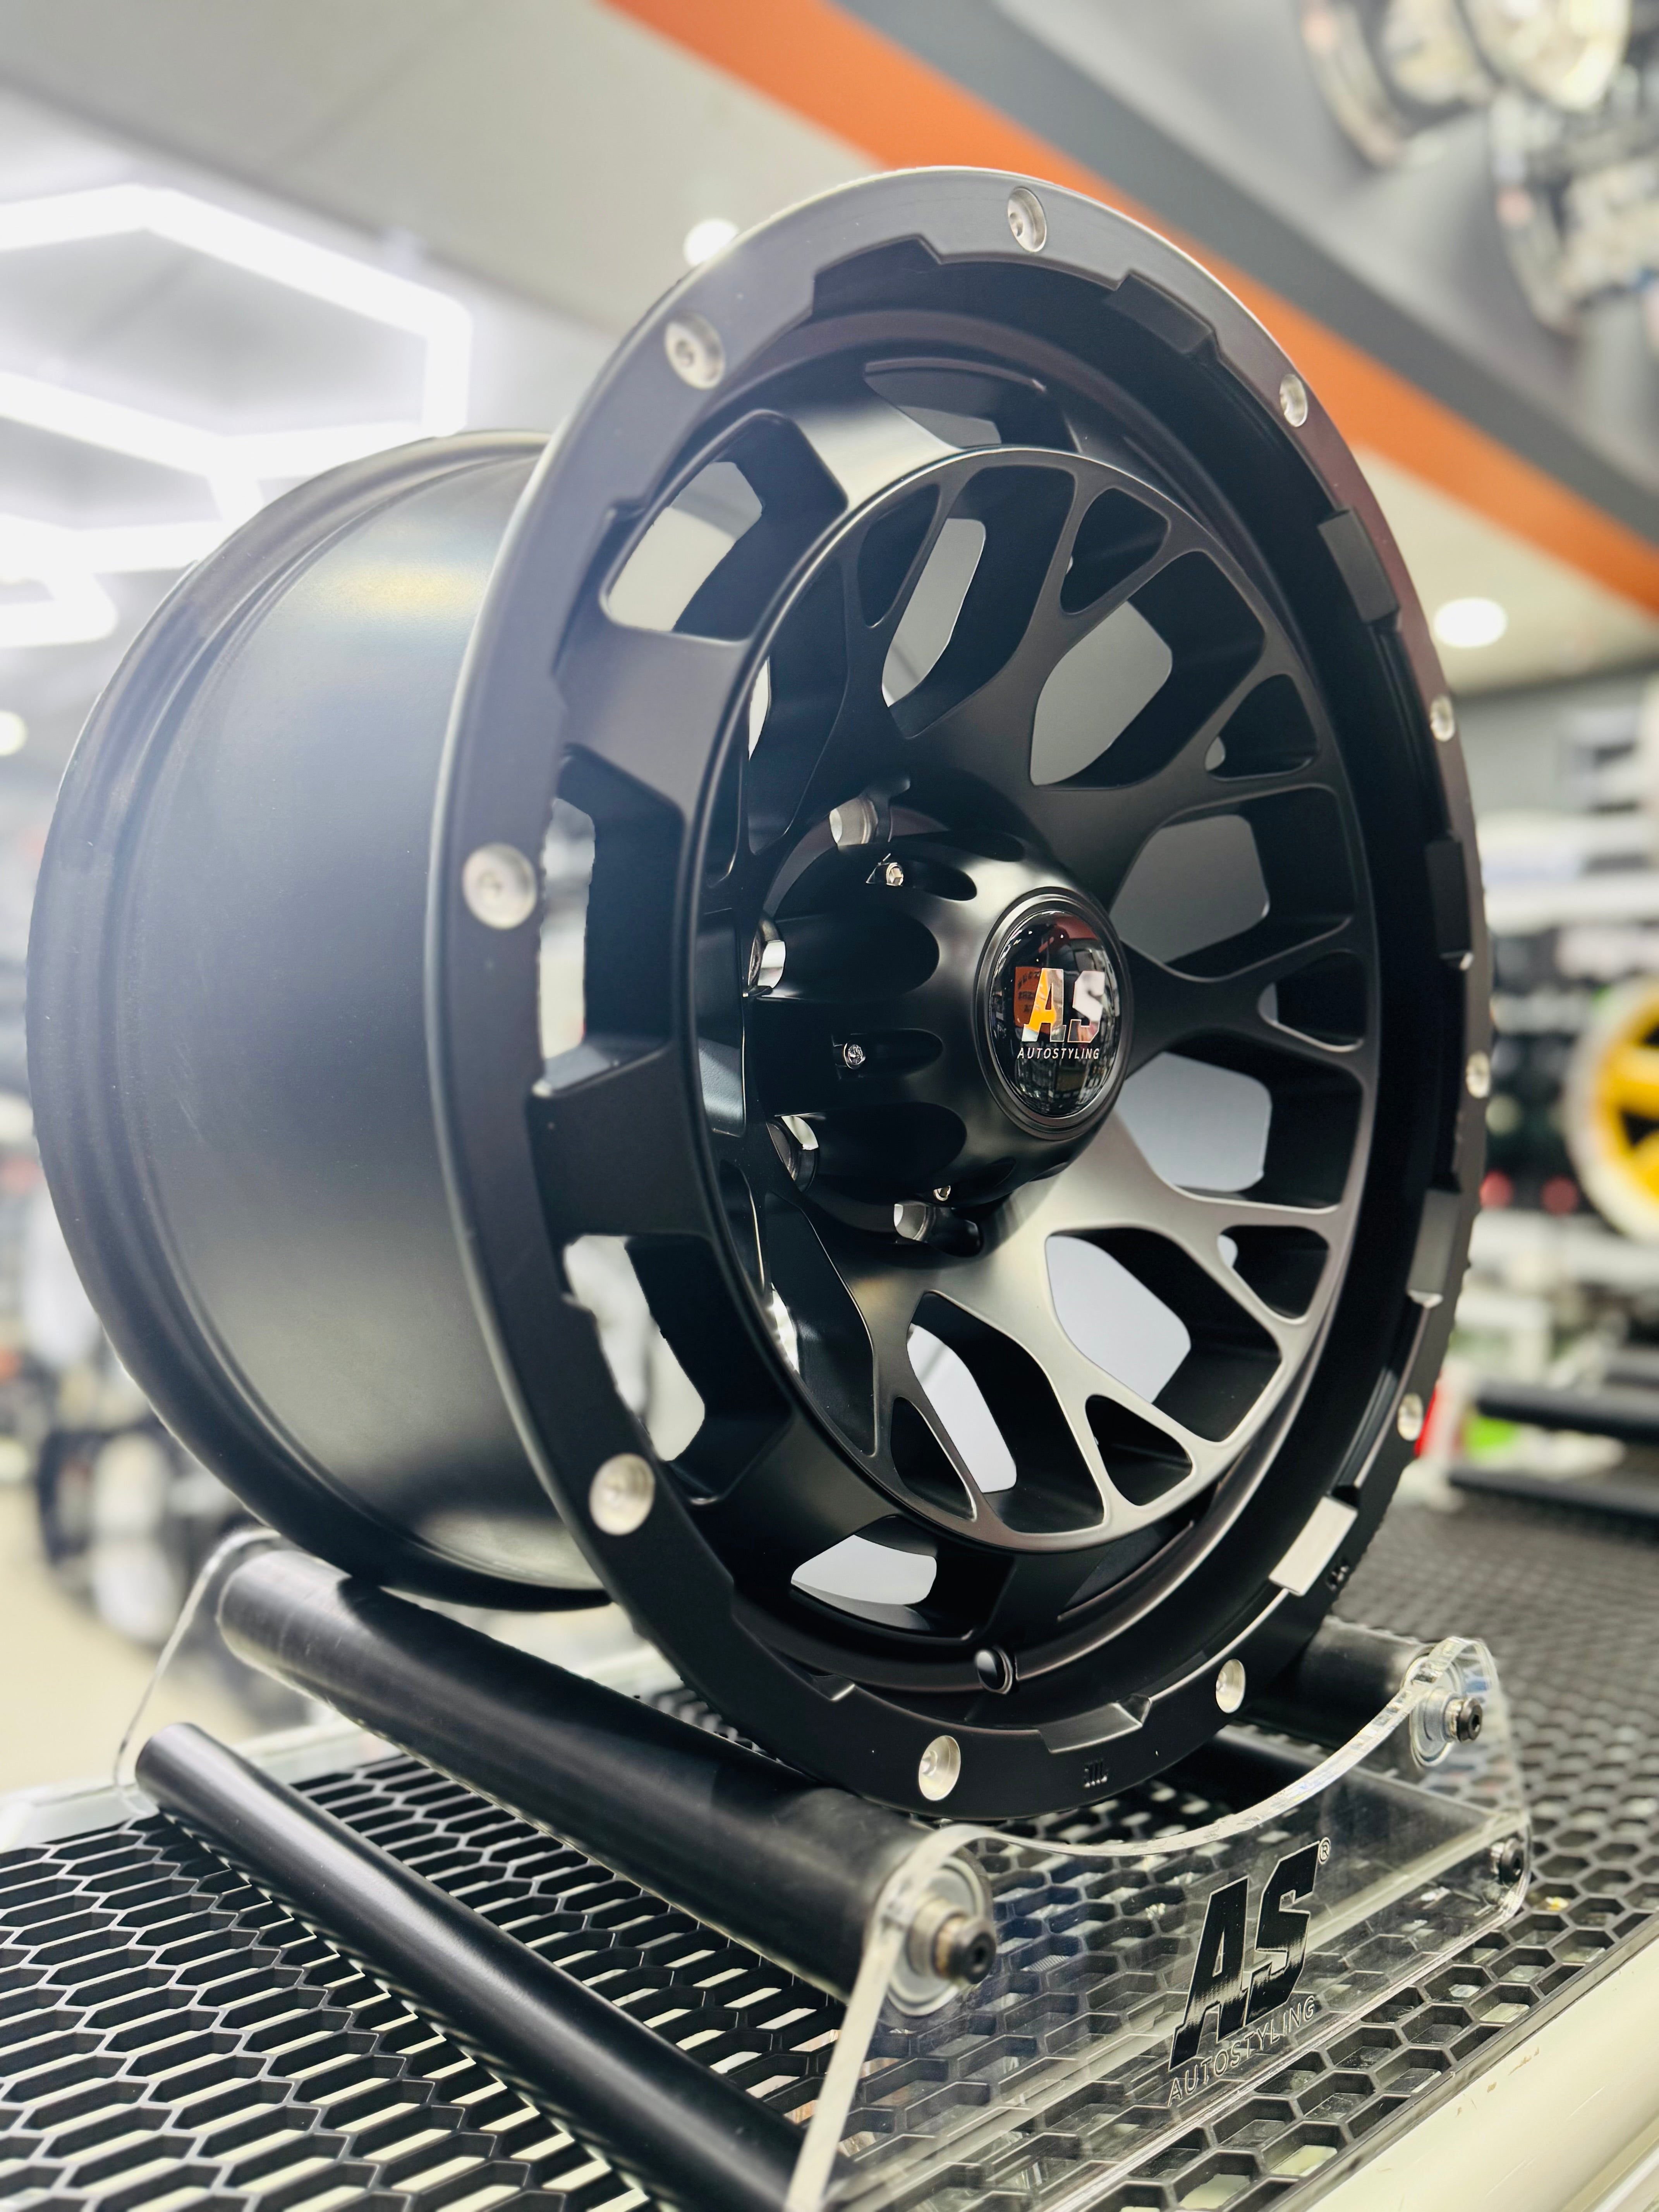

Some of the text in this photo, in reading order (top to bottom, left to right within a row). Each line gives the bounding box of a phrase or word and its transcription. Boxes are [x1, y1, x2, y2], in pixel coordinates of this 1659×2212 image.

[1022, 968, 1105, 1042] AS
[1017, 1048, 1099, 1060] AUTOSTYLING
[1168, 1995, 1316, 2106] AUTOSTYLING
